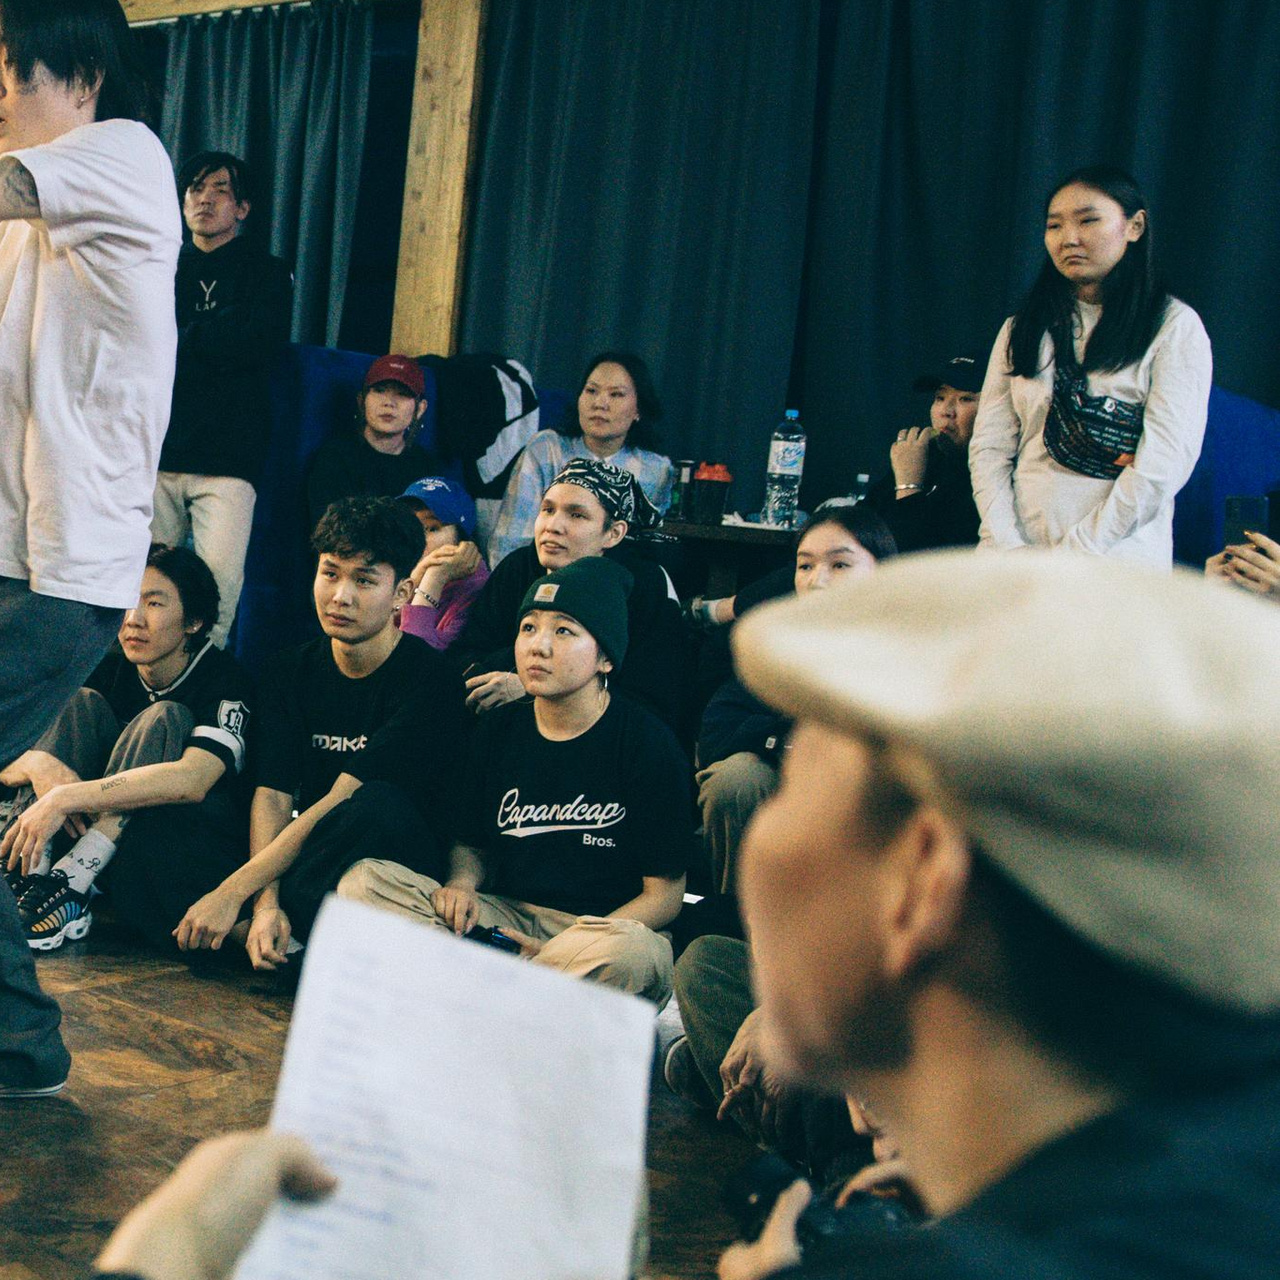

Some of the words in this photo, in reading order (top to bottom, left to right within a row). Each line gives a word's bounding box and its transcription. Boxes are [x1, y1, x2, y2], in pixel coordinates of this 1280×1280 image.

[199, 280, 217, 301] Y
[497, 787, 626, 835] Capandcap
[582, 833, 616, 848] Bros.
